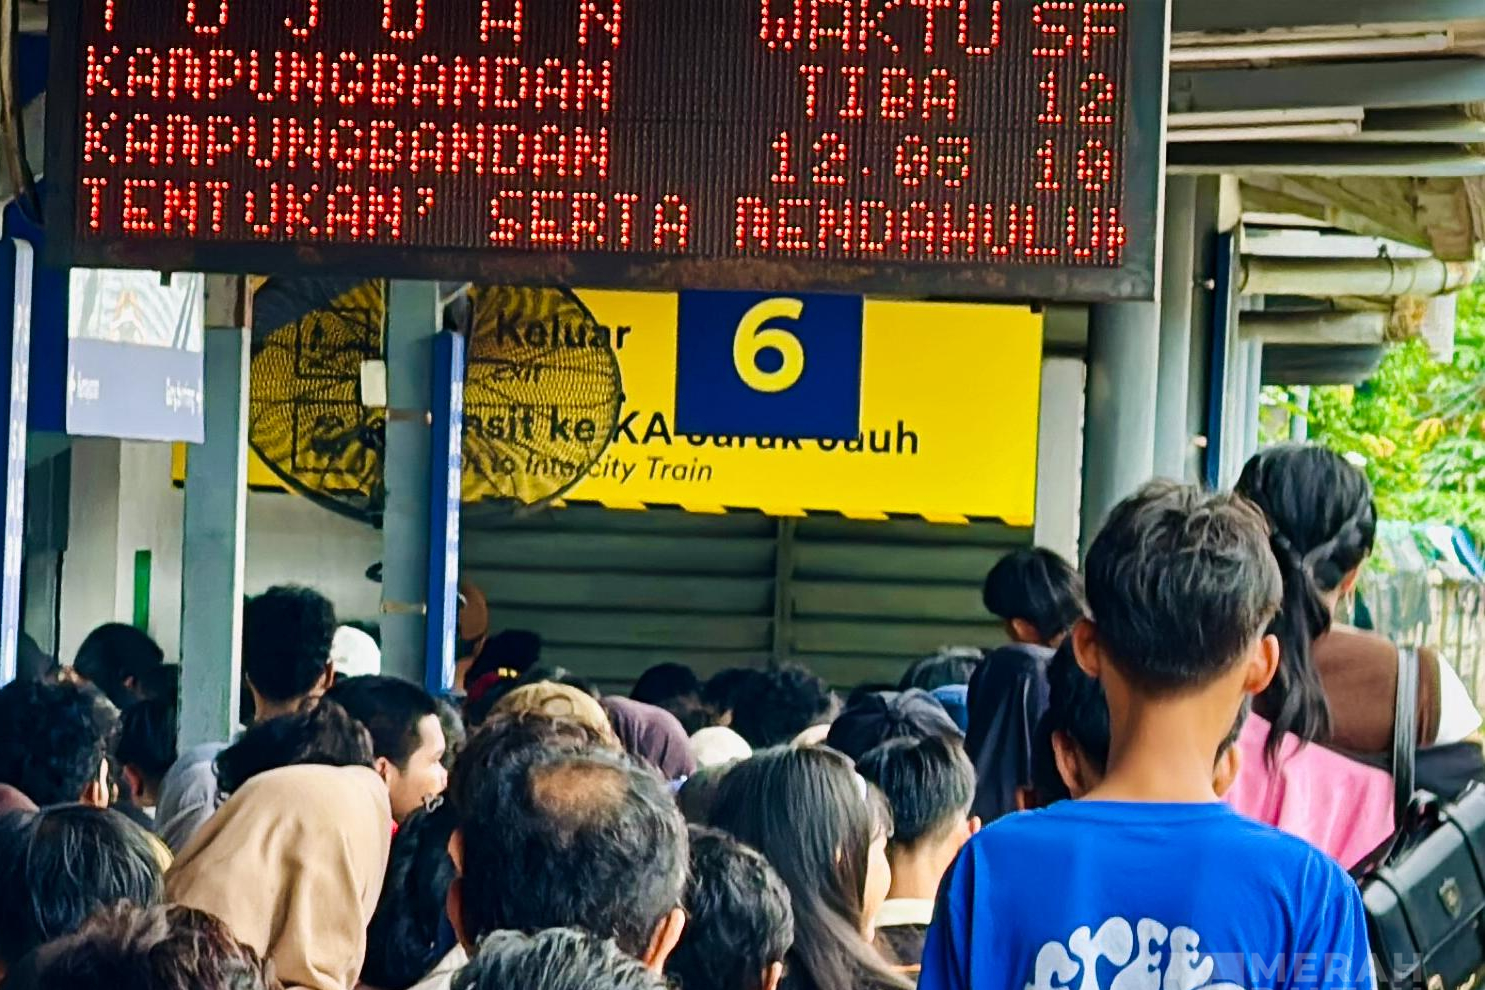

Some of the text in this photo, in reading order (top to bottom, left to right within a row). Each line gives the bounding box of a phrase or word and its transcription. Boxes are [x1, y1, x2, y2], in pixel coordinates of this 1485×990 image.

[759, 0, 1000, 54] WAKTU
[1032, 2, 1125, 56] SF
[86, 45, 1113, 123] KAMPUNGBANDAN TIBA 12
[84, 111, 608, 177] KAMPUNGBANDAN
[1035, 139, 1110, 191] 10
[489, 190, 688, 246] SERTA
[732, 296, 805, 393] 6
[549, 405, 597, 443] ke
[611, 410, 672, 446] KA
[646, 456, 714, 483] Train
